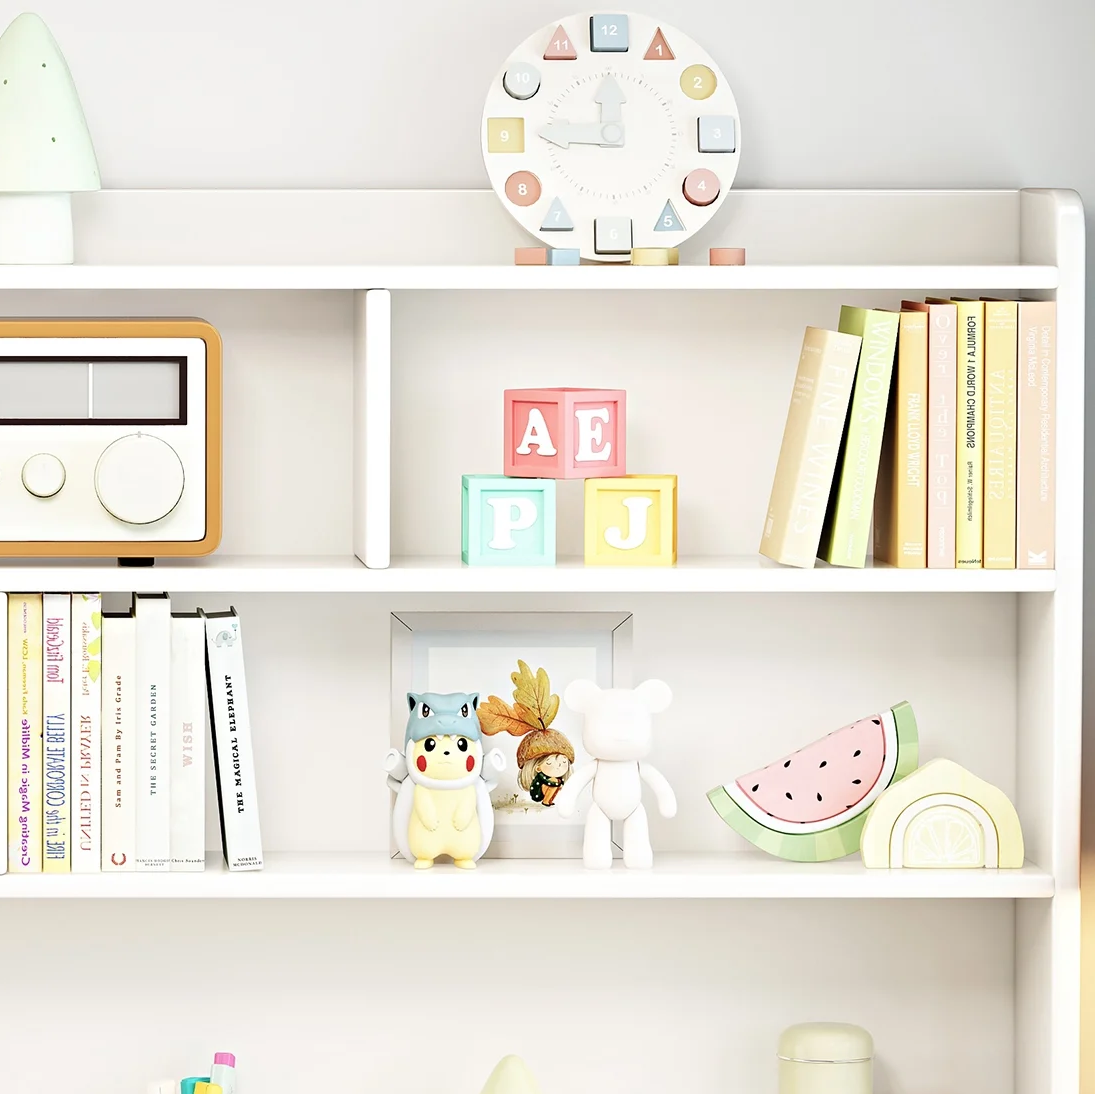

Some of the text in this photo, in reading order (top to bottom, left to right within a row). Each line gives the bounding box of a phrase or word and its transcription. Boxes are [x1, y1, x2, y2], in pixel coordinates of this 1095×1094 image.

[601, 25, 618, 36] 12
[554, 40, 569, 50] 11
[656, 45, 663, 56] 1
[515, 73, 530, 83] 10
[693, 76, 703, 88] 2
[500, 131, 509, 142] 9
[713, 128, 721, 139] 3
[518, 184, 527, 195] 8
[697, 180, 707, 191] 4
[553, 211, 562, 222] 7
[664, 215, 673, 227] 5
[516, 408, 558, 457] A
[574, 407, 612, 462] E
[907, 392, 921, 487] FRANK LLOYD WRIGHT
[485, 496, 538, 551] P
[603, 496, 654, 550] J
[116, 729, 122, 739] By
[183, 722, 192, 767] WISH
[223, 674, 244, 814] THE MAGICAL ELEPHANT
